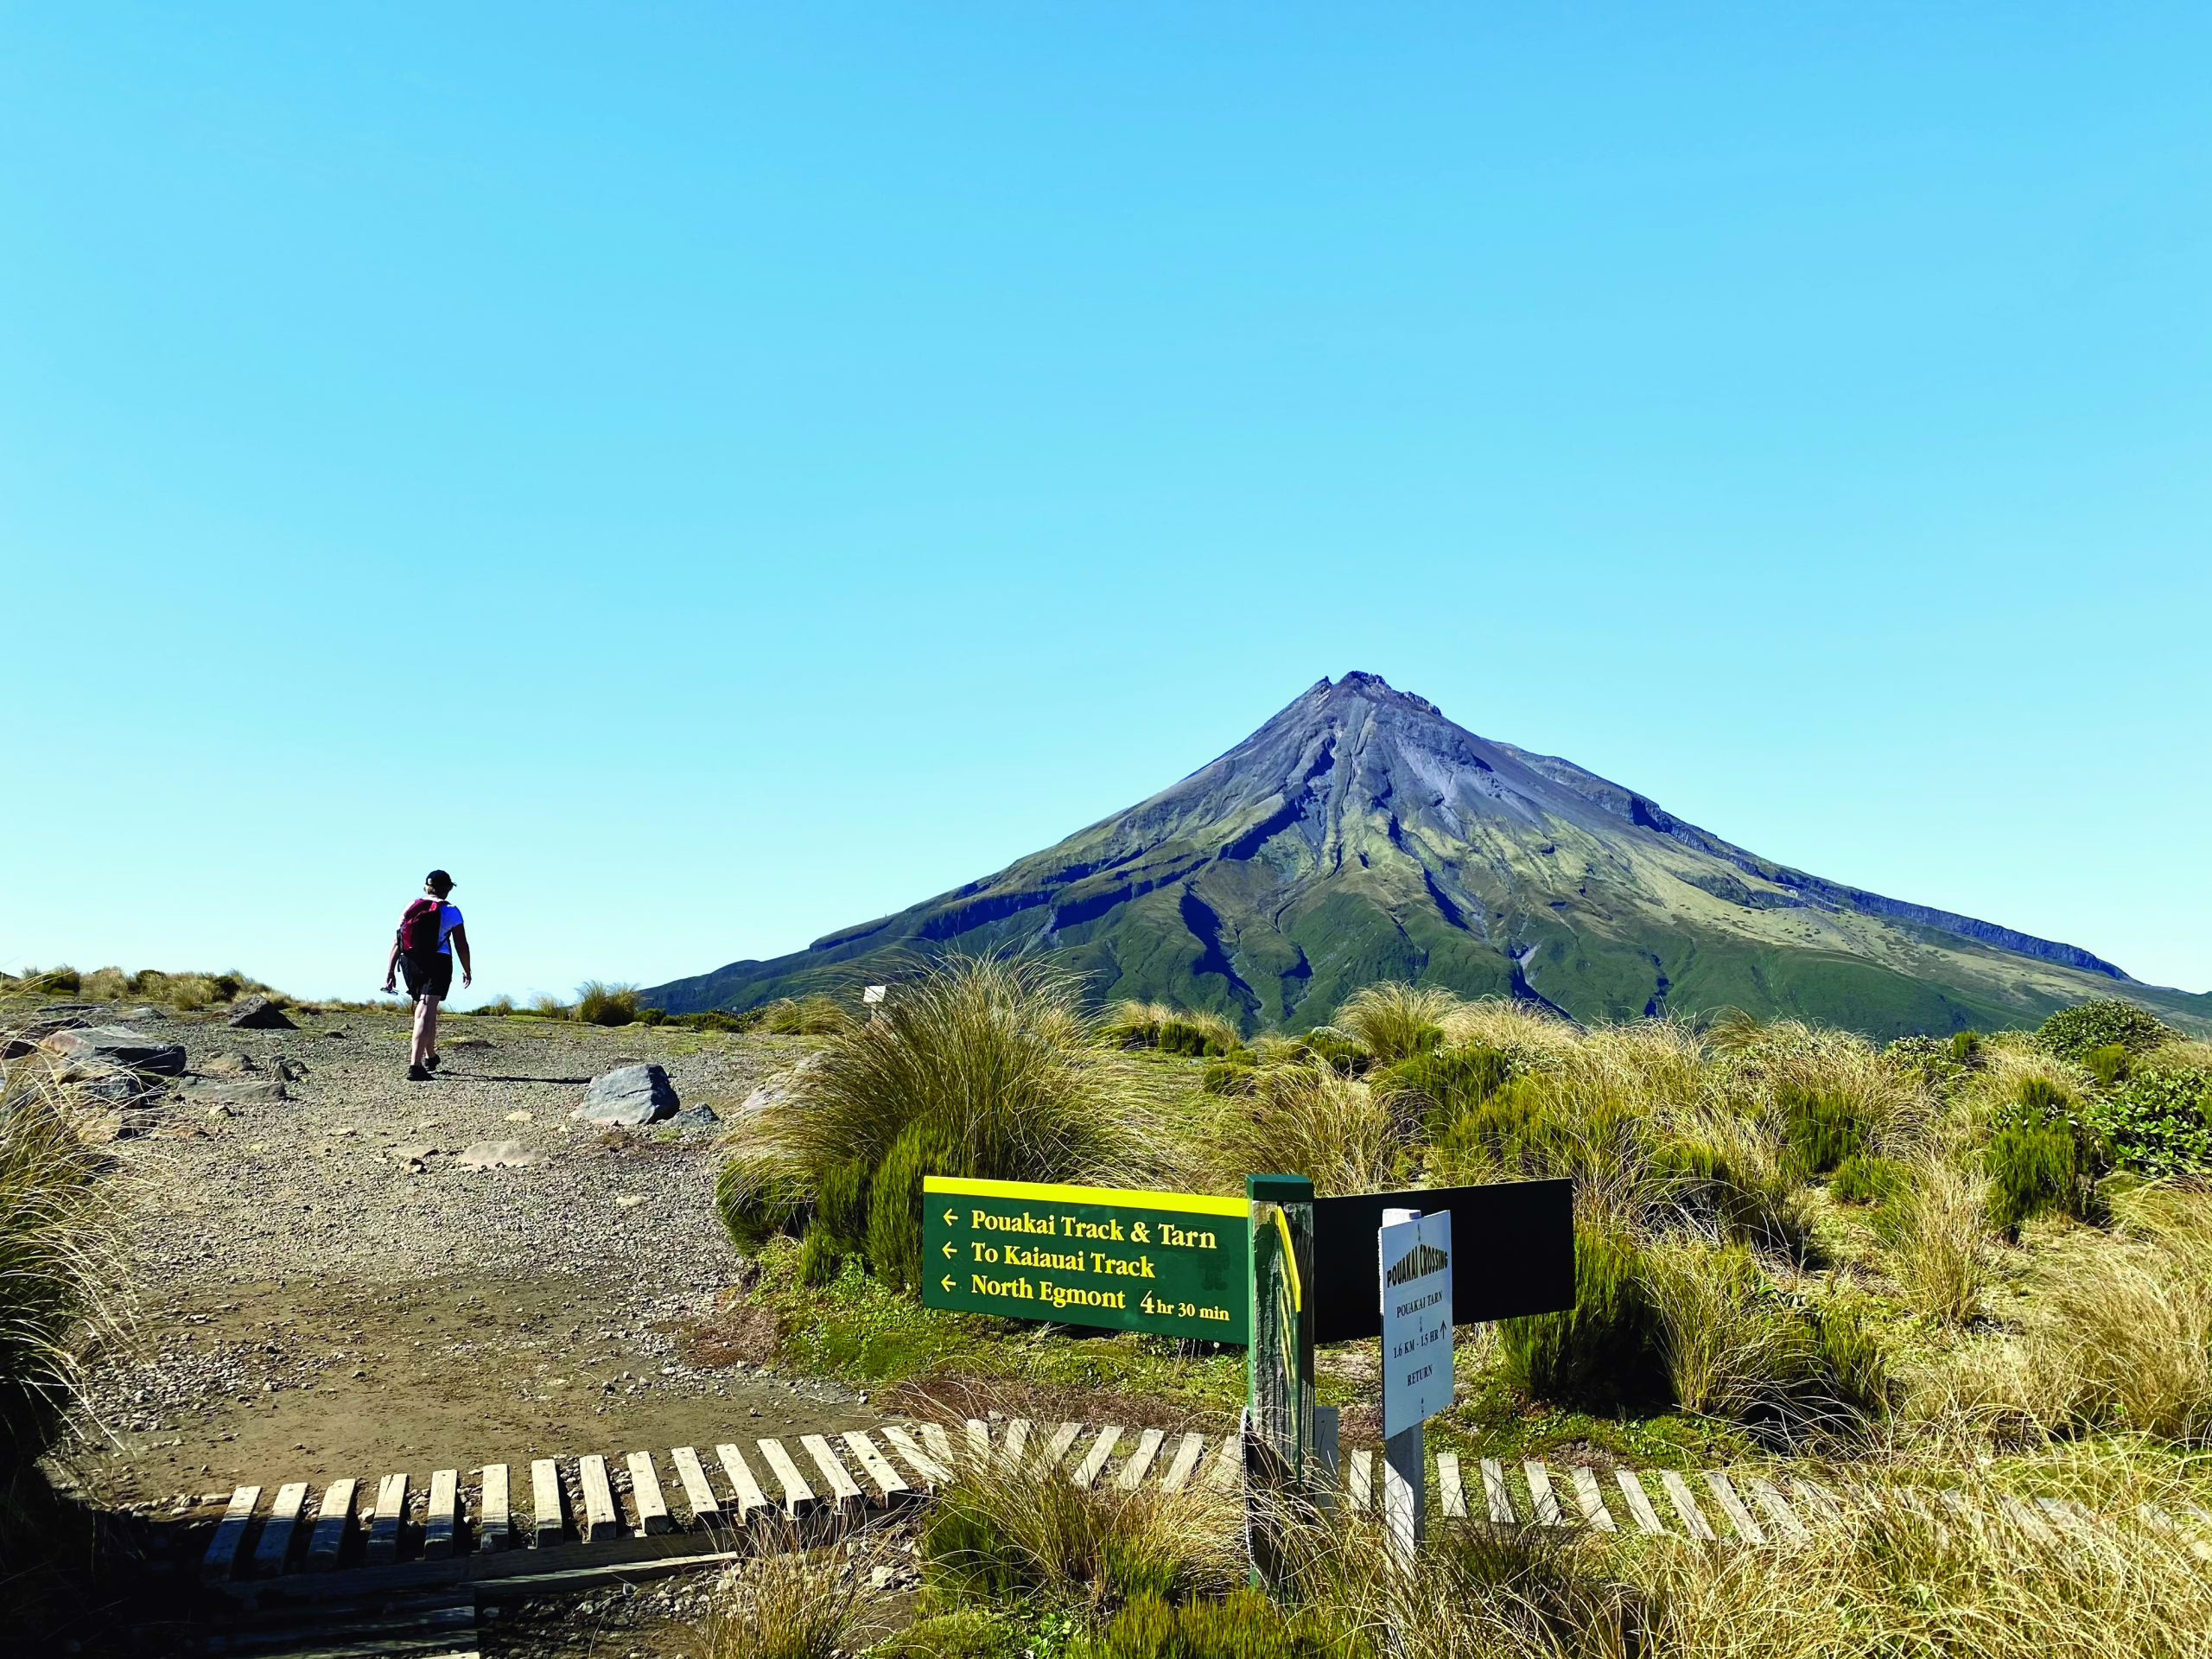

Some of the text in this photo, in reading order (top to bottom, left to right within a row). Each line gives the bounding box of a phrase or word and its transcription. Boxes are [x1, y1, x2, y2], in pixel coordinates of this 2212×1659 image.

[971, 1210, 1217, 1249] Pouakai Track & Tarn
[970, 1241, 1156, 1279] To Kaiauai Track
[1386, 1243, 1448, 1288] POUAKAI CROSSING
[970, 1274, 1034, 1300] North
[1039, 1281, 1127, 1309] Egmont
[1178, 1302, 1196, 1318] 30
[1198, 1306, 1230, 1321] min
[1396, 1290, 1443, 1319] POUAKAI TARN
[1393, 1343, 1403, 1359] 1.6
[1404, 1338, 1415, 1355] KM
[1429, 1329, 1439, 1344] HR
[1407, 1363, 1433, 1387] RETURN
